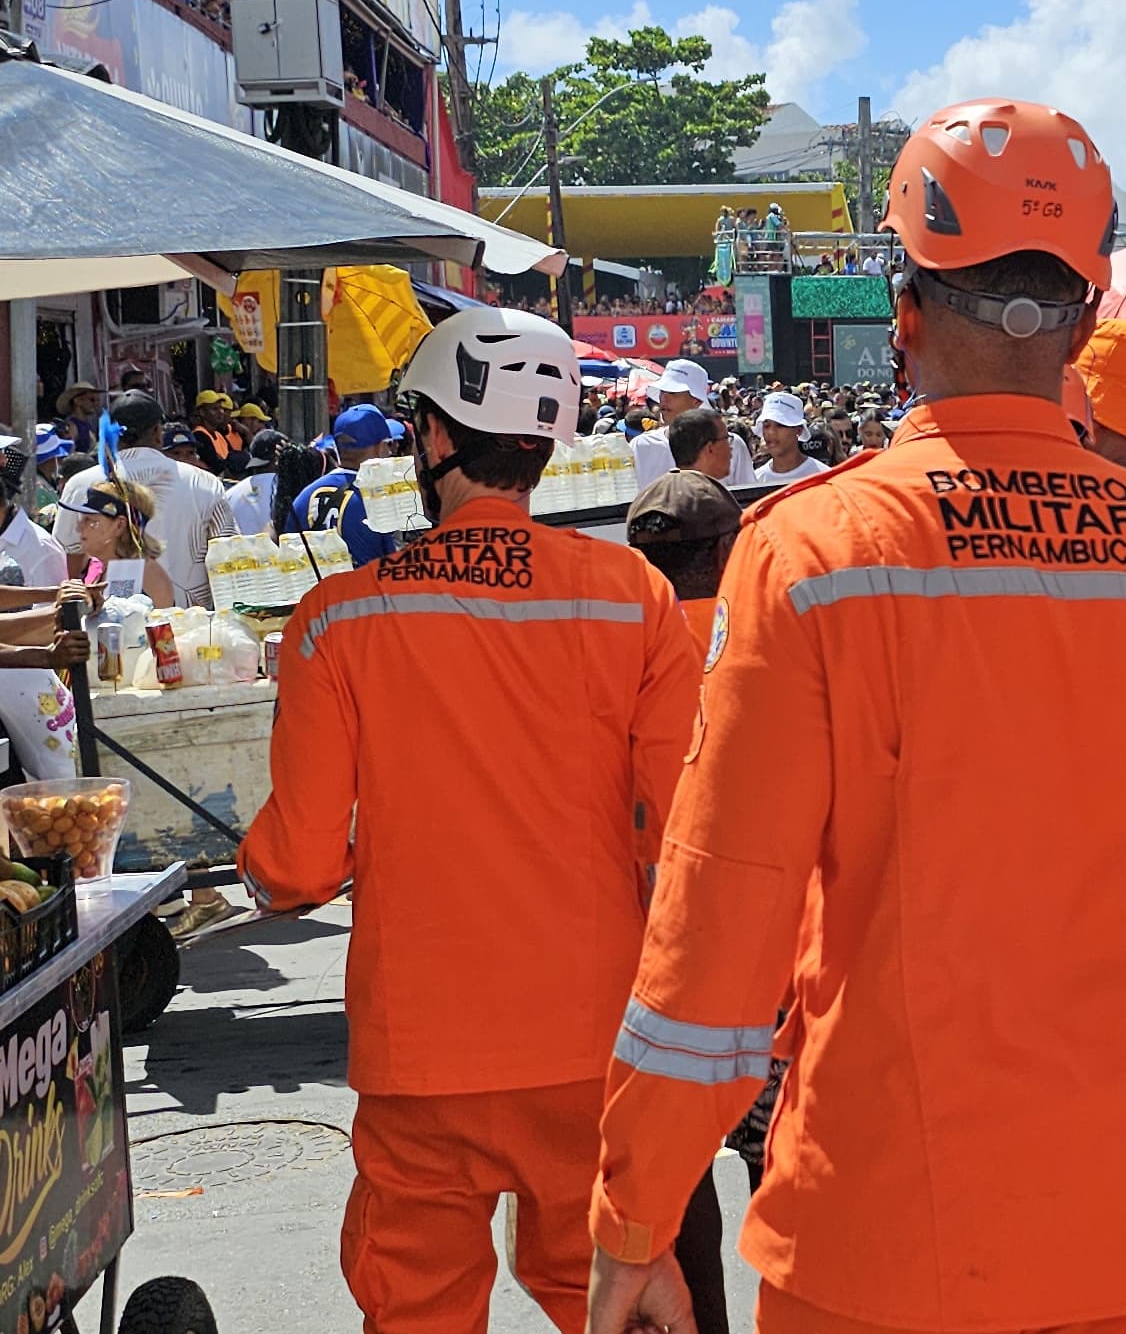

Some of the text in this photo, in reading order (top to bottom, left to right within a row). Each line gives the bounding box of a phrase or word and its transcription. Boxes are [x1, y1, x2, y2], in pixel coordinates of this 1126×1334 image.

[411, 528, 531, 546] MBEIRO
[379, 544, 532, 567] MILITAR
[377, 563, 532, 589] PERNAMBUCO
[0, 1009, 67, 1119] Mega
